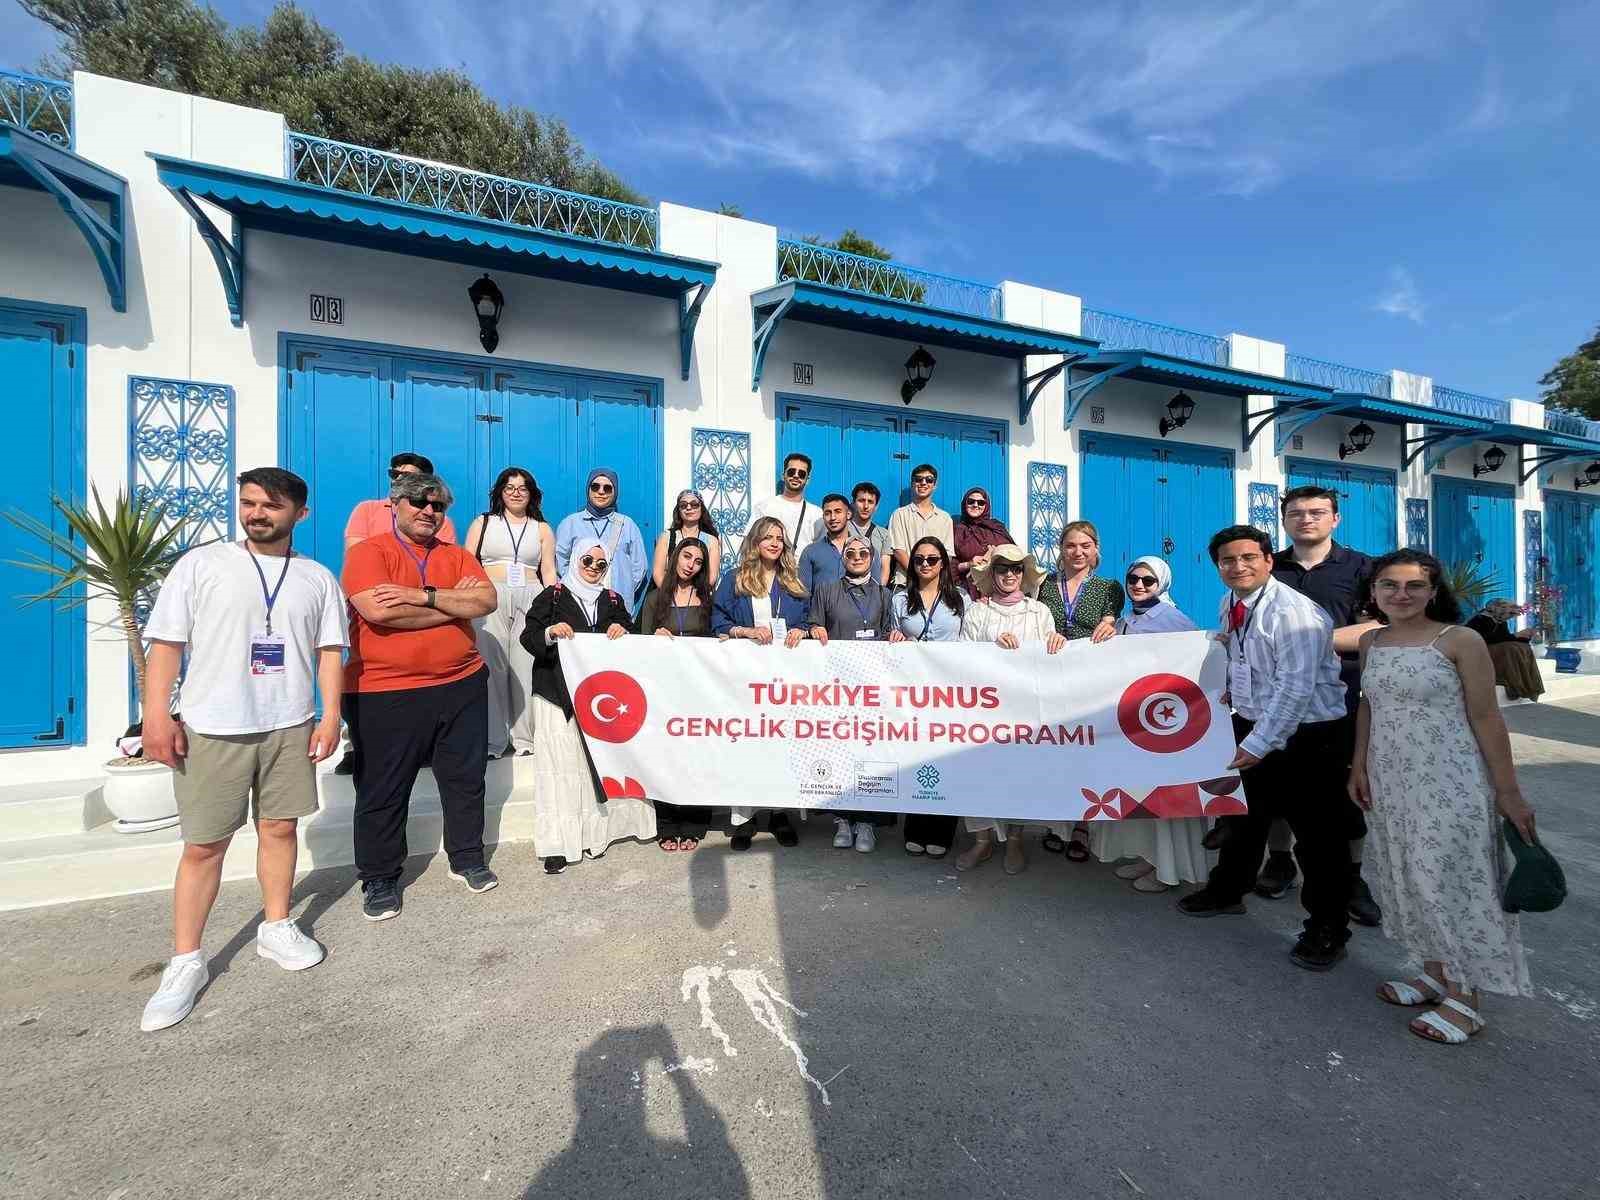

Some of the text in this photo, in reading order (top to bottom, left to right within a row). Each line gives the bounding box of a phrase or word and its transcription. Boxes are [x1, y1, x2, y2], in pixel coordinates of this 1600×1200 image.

[312, 297, 340, 321] 03
[749, 678, 1000, 709] TÜRKİYE TUNUS
[666, 713, 1095, 746] GENÇLİK DEĞİŞİMİ PROGRAMI
